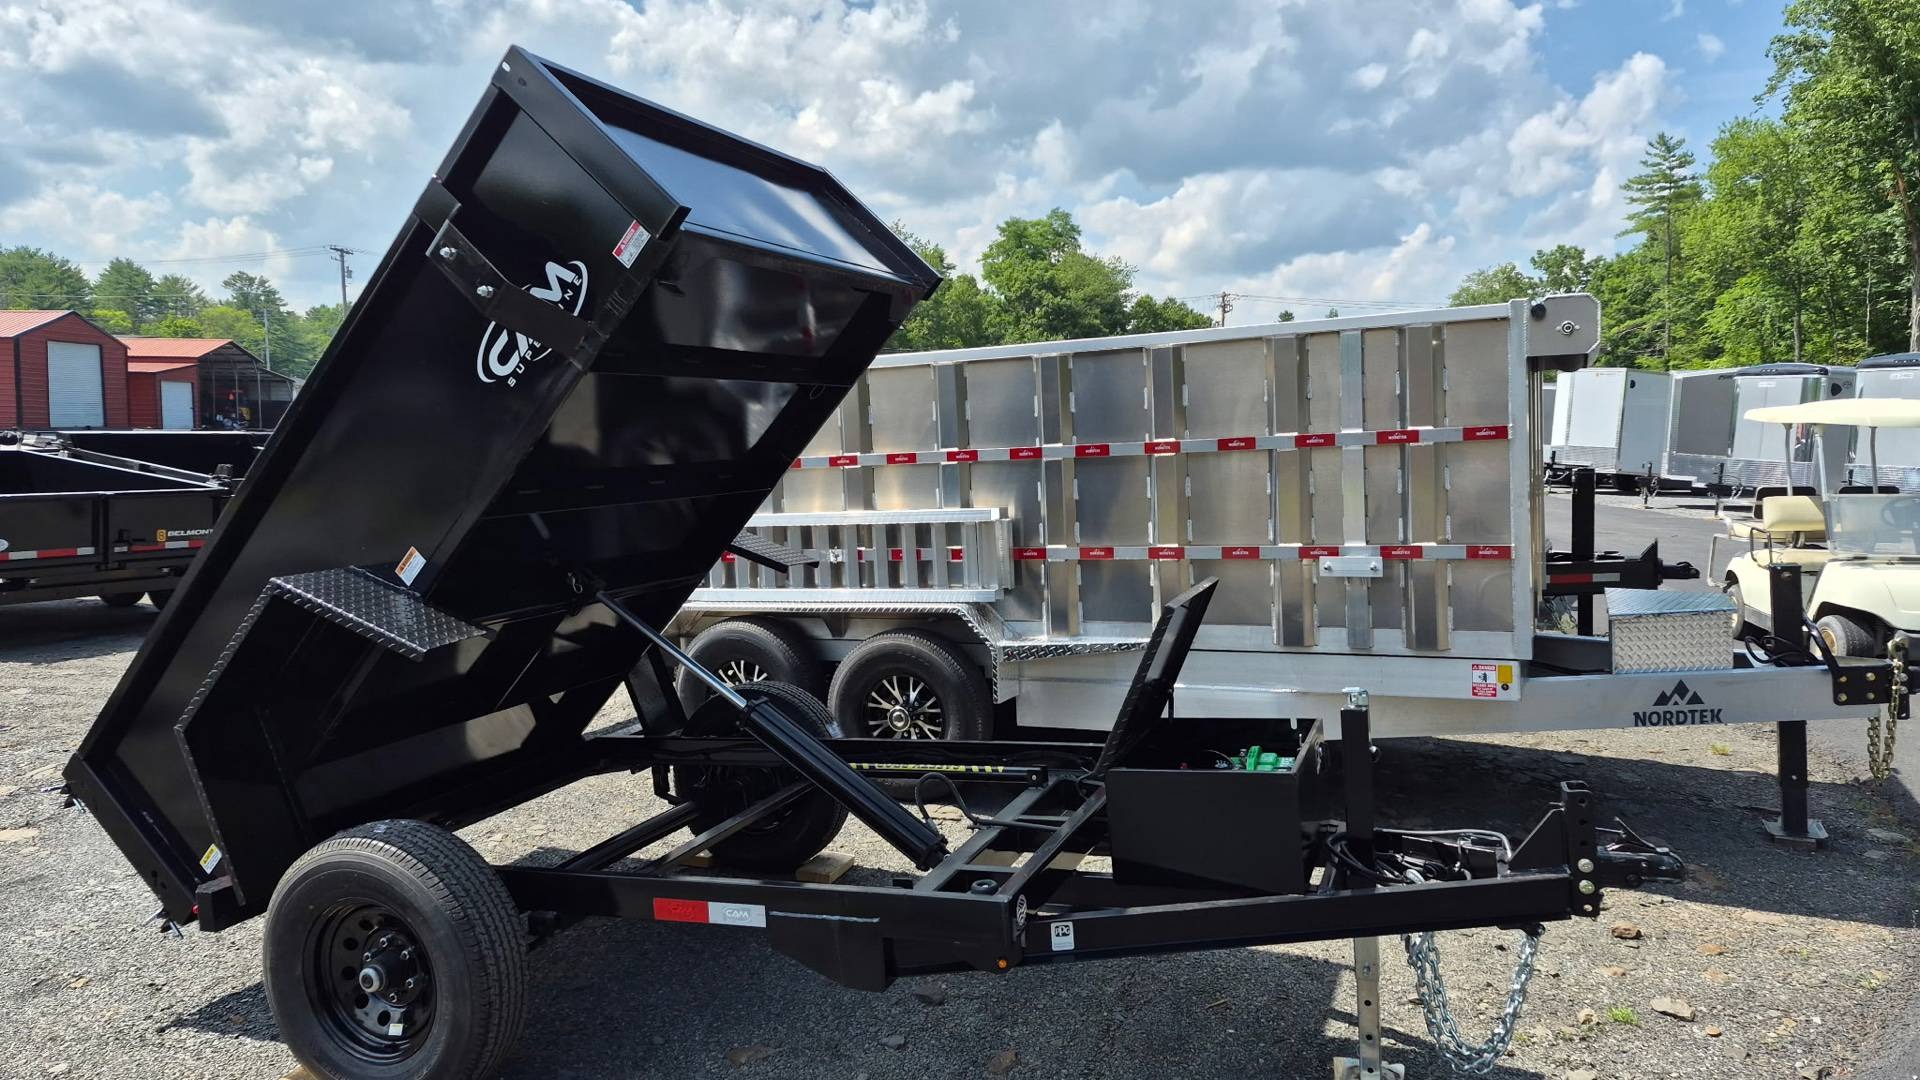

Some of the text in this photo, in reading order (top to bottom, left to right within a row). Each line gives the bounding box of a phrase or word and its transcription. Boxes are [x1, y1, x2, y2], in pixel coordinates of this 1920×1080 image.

[488, 261, 577, 377] CM
[507, 275, 582, 388] SUPEINE
[1632, 708, 1724, 727] NORDTEK
[725, 909, 749, 919] CAM
[1055, 926, 1071, 937] PPG
